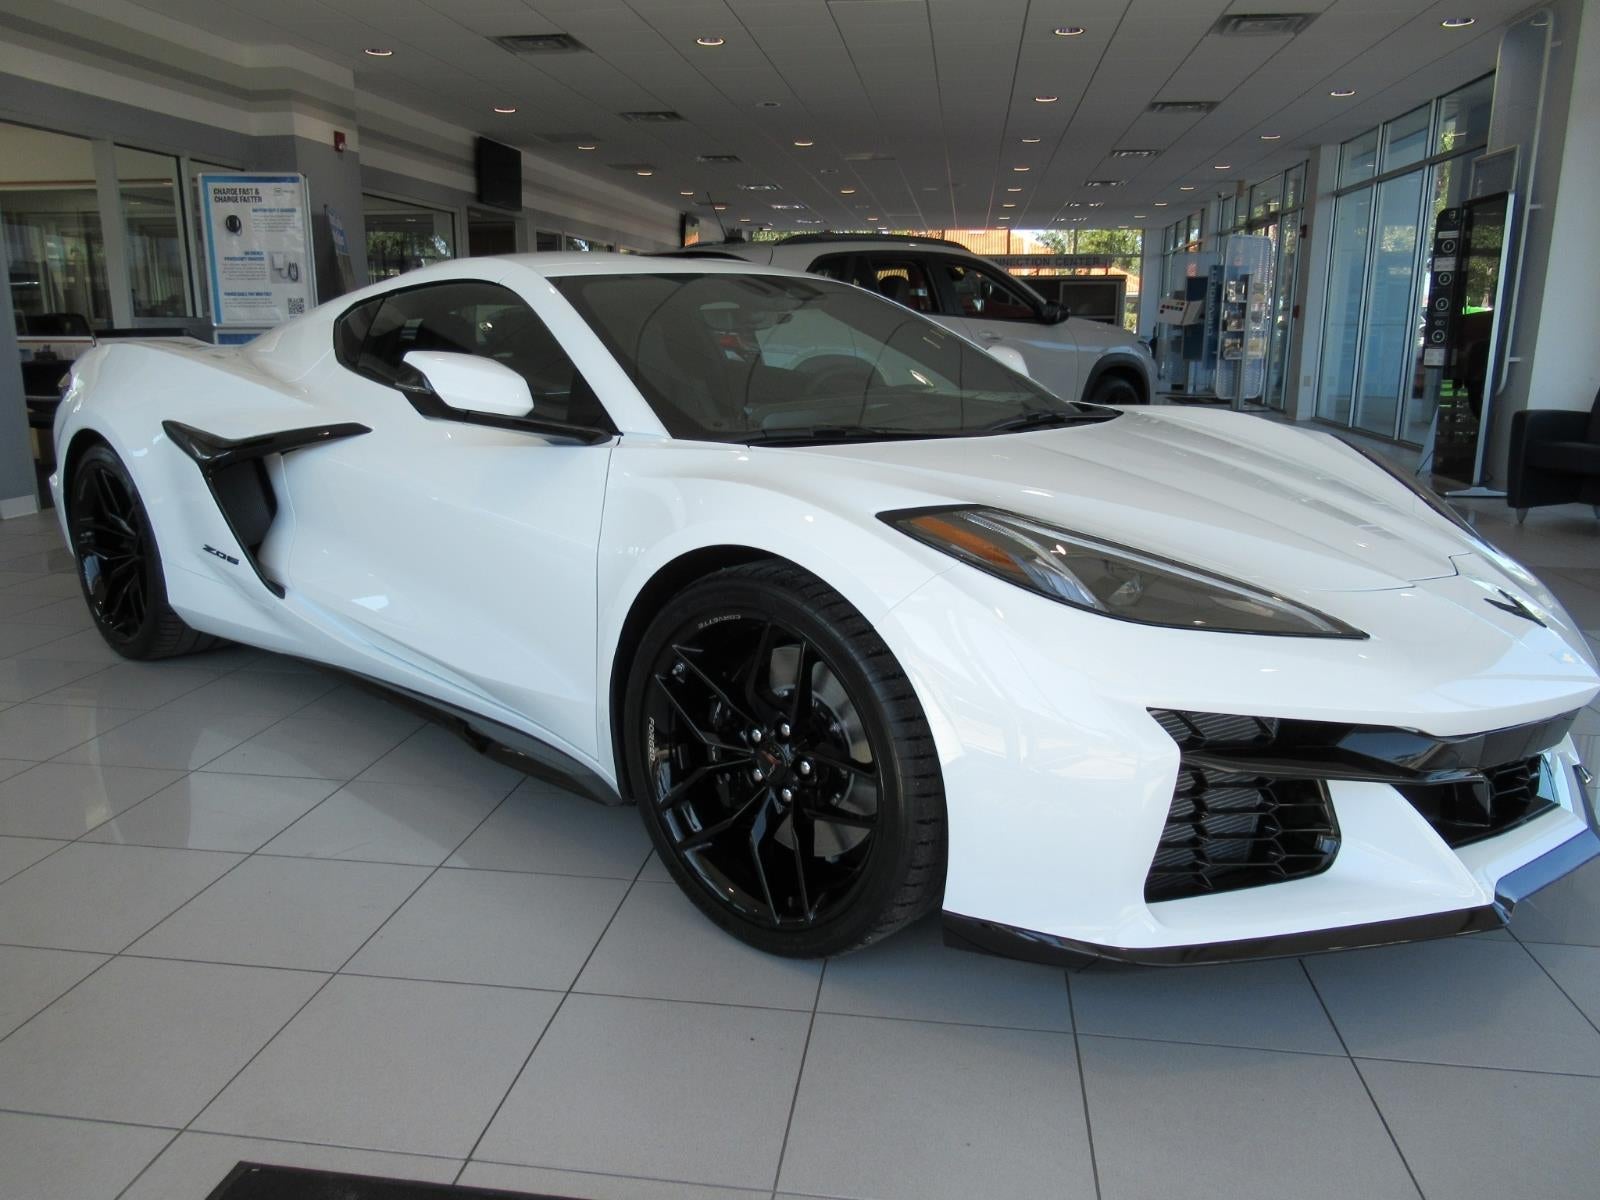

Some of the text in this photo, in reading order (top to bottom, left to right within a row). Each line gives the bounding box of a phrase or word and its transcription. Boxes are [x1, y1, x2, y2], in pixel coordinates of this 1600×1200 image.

[213, 187, 260, 195] CHARGE FAST &
[214, 195, 262, 203] CHARGE FASTER
[1055, 257, 1100, 266] CENTER
[1207, 268, 1218, 337] CHEVROLET
[202, 544, 240, 566] Z06
[698, 614, 741, 630] CORVETTE
